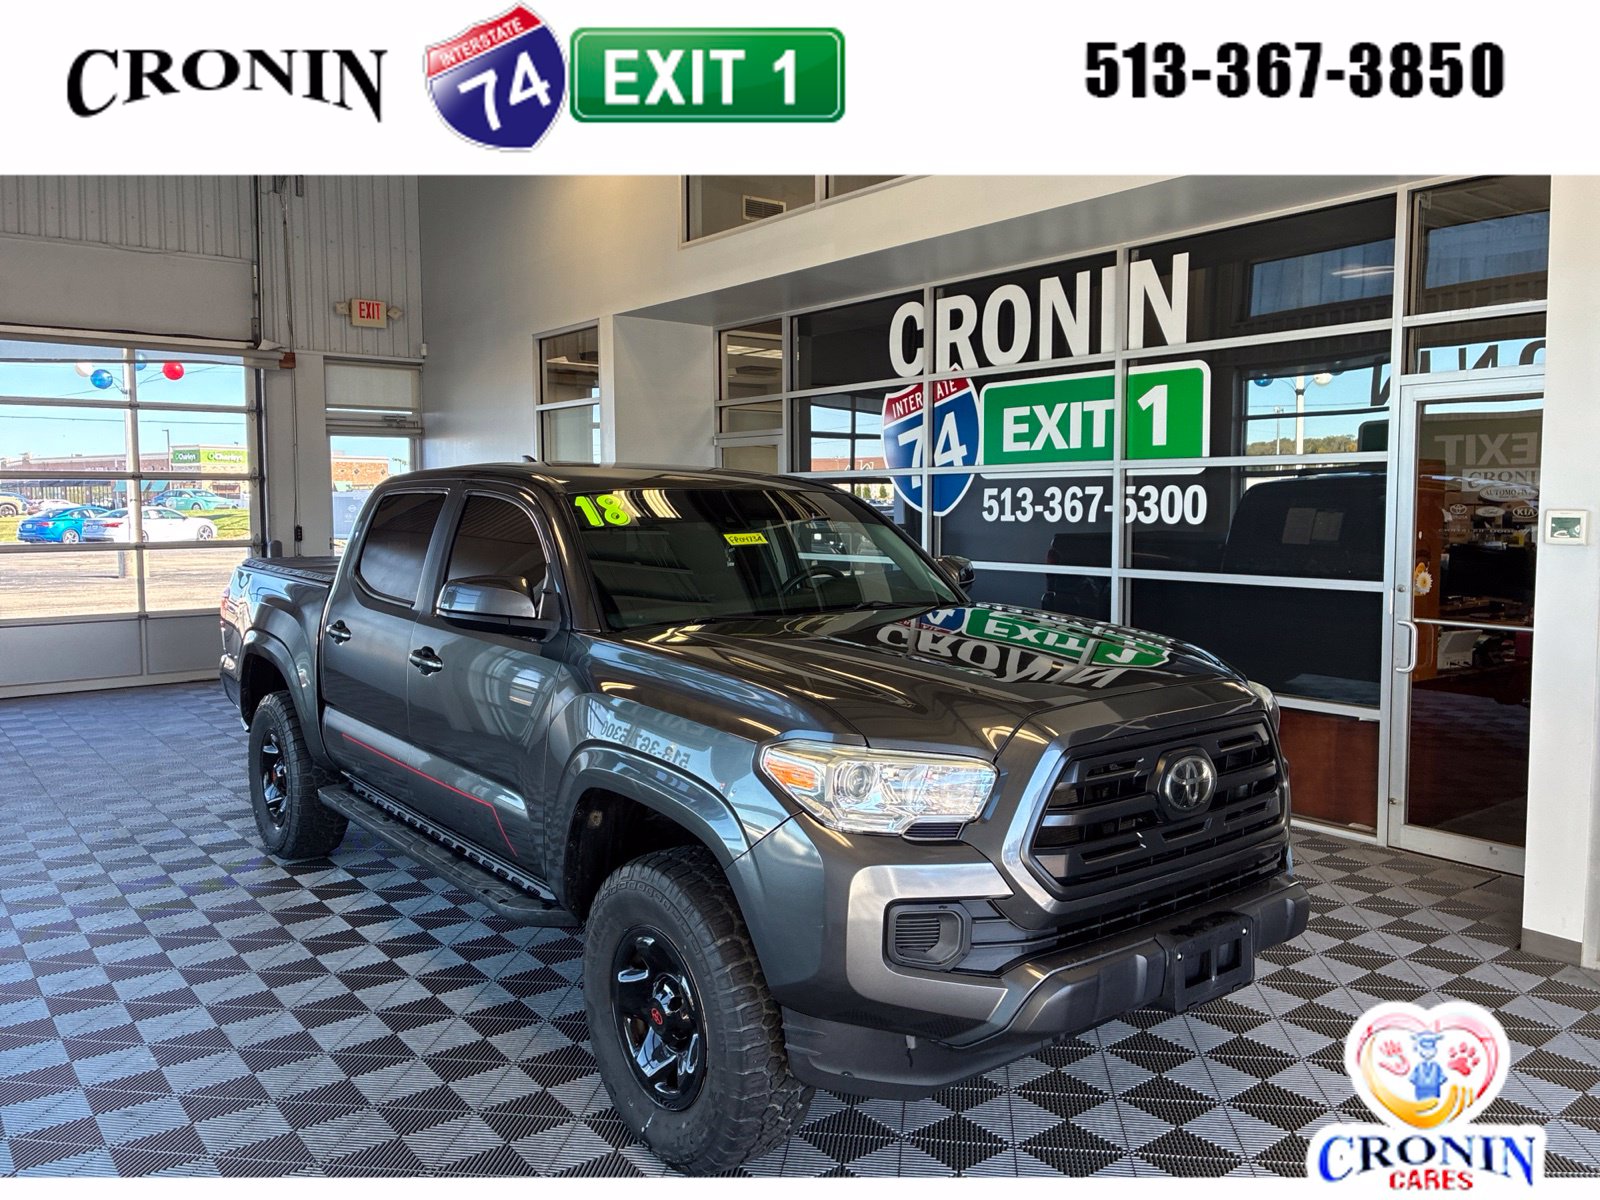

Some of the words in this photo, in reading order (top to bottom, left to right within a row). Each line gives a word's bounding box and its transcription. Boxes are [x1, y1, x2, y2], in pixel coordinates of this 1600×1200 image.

[358, 300, 381, 321] EXIT
[889, 252, 1189, 378] CRONIN
[892, 379, 958, 419] INTERATE
[1003, 399, 1115, 452] EXIT
[1137, 384, 1168, 446] 1
[898, 411, 968, 489] 74
[1467, 470, 1539, 489] CRONI
[575, 494, 631, 527] 18
[982, 485, 1208, 525] 513-367-5300
[1516, 508, 1535, 517] KIA
